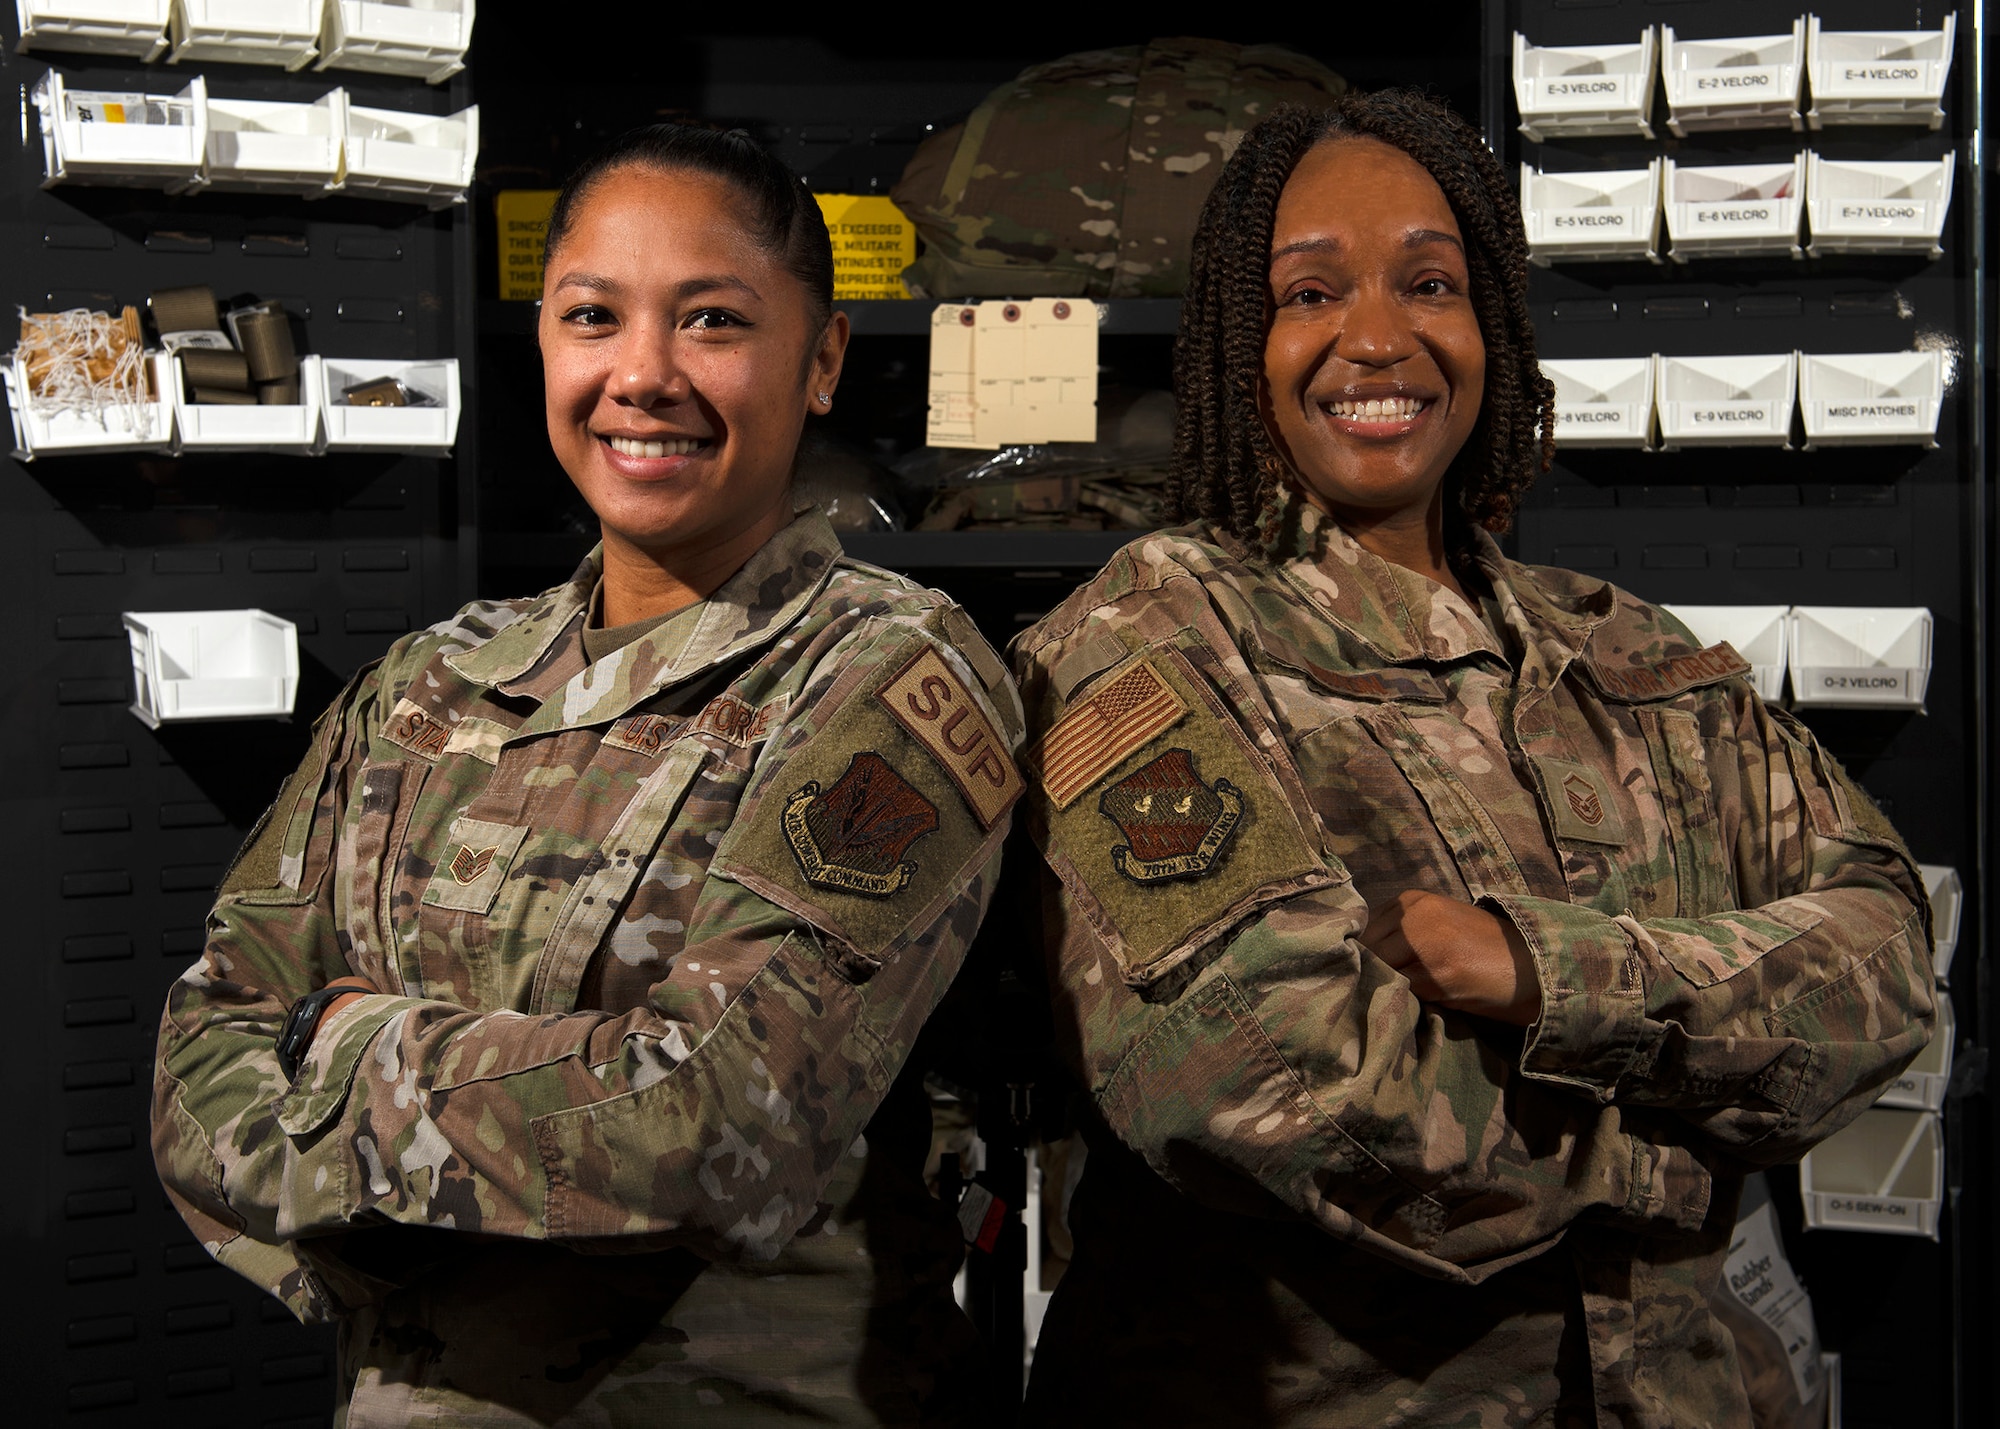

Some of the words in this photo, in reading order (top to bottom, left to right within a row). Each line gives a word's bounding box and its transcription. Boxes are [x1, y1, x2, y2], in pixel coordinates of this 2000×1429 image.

[1845, 69, 1866, 80] E-4
[1869, 68, 1918, 79] VELCRO
[1548, 83, 1568, 94] E-3
[1570, 82, 1617, 93] VELCRO
[1698, 78, 1719, 89] E-2
[1721, 75, 1768, 87] VELCRO
[1698, 211, 1719, 222] E-6
[1721, 209, 1768, 220] VELCRO
[1842, 207, 1863, 218] E-7
[1866, 207, 1915, 218] VELCRO
[1555, 216, 1575, 227] E-5
[1577, 215, 1623, 226] VELCRO
[842, 224, 902, 235] EXCEEDED
[509, 237, 532, 248] THE
[508, 254, 534, 266] OUR
[834, 257, 884, 268] NTINUES
[889, 257, 902, 268] TO
[508, 271, 537, 282] THIS
[834, 291, 901, 300] PECTATIONS
[1575, 411, 1620, 422] VELCRO
[1694, 411, 1715, 422] E-9
[1717, 410, 1764, 421] VELCRO
[1828, 406, 1858, 417] MISC
[1860, 405, 1916, 416] PATCHES
[1656, 644, 1741, 689] FORCE
[1824, 676, 1847, 688] O-2
[1849, 675, 1897, 688] VELCRO
[396, 712, 451, 755] STA
[907, 675, 1006, 788] SUP
[1143, 862, 1176, 876] 70TH
[1204, 812, 1238, 847] WING
[825, 868, 888, 891] COMMAND
[1855, 1201, 1906, 1216] SEW-ON
[1730, 1255, 1772, 1292] Rubber
